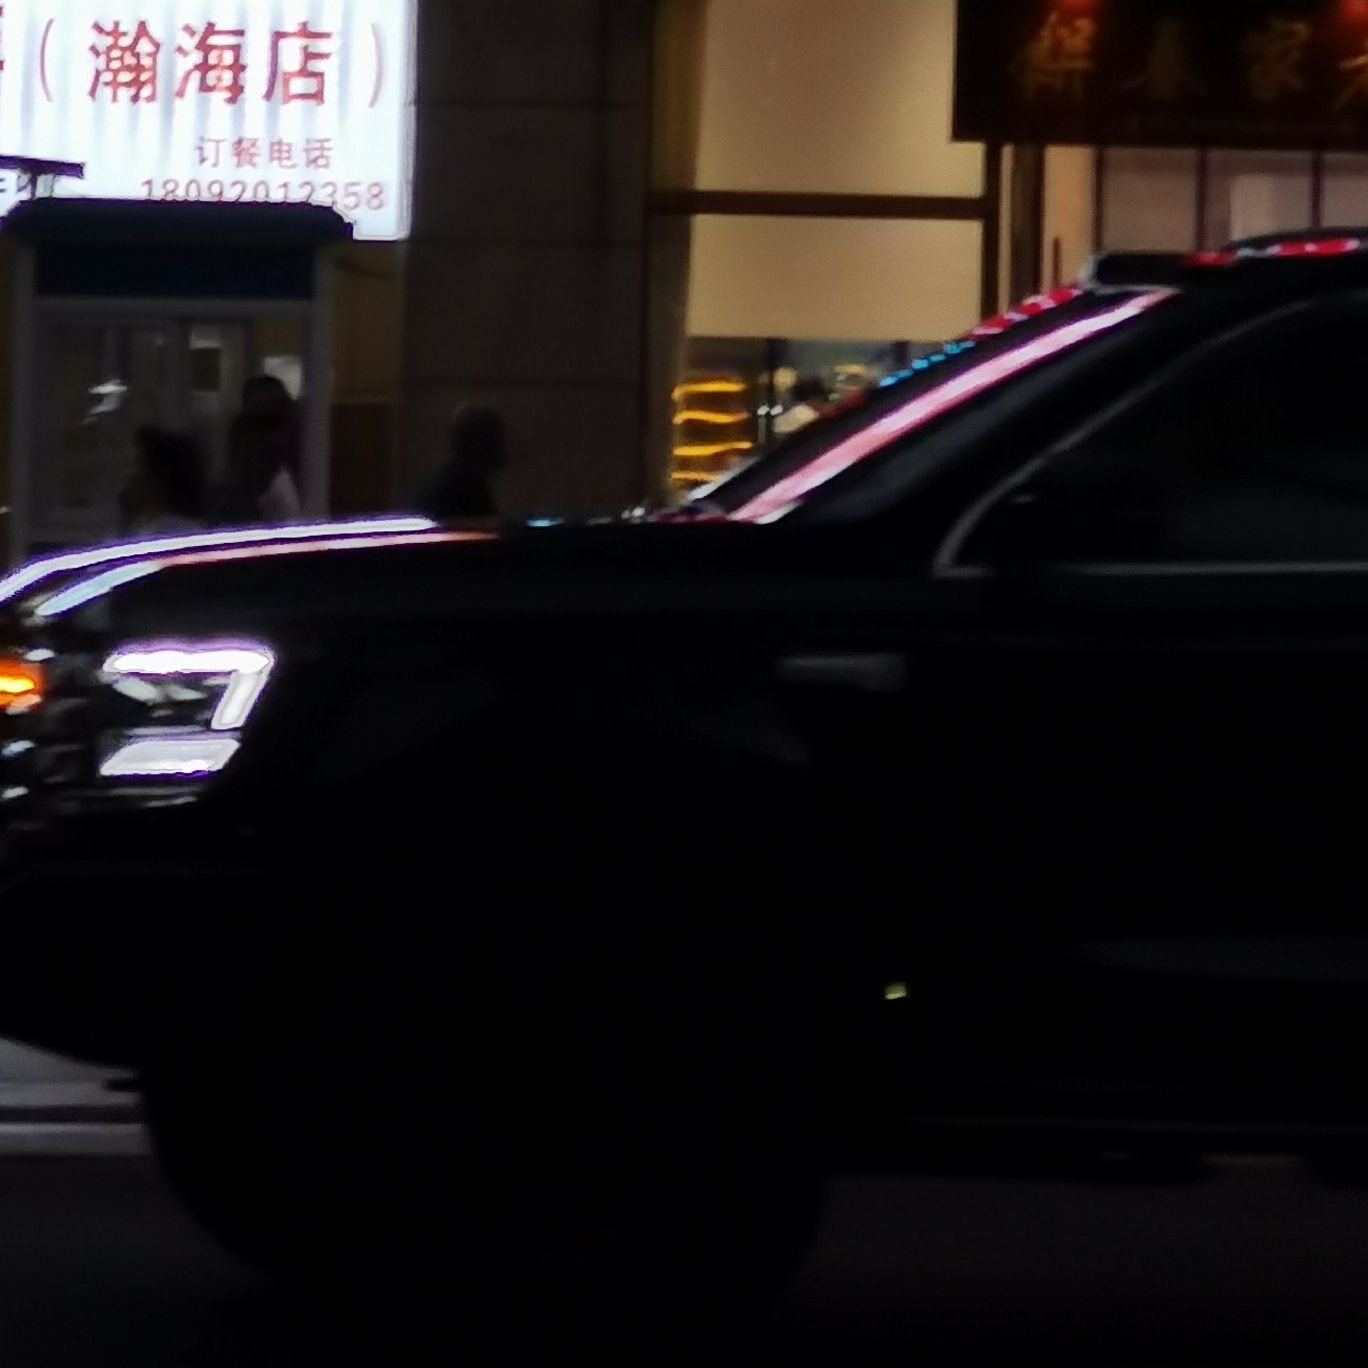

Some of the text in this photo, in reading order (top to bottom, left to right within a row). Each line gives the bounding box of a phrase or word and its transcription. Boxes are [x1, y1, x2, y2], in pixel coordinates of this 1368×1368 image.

[194, 135, 333, 170] 订餐电话
[140, 179, 385, 211] 18092012358
